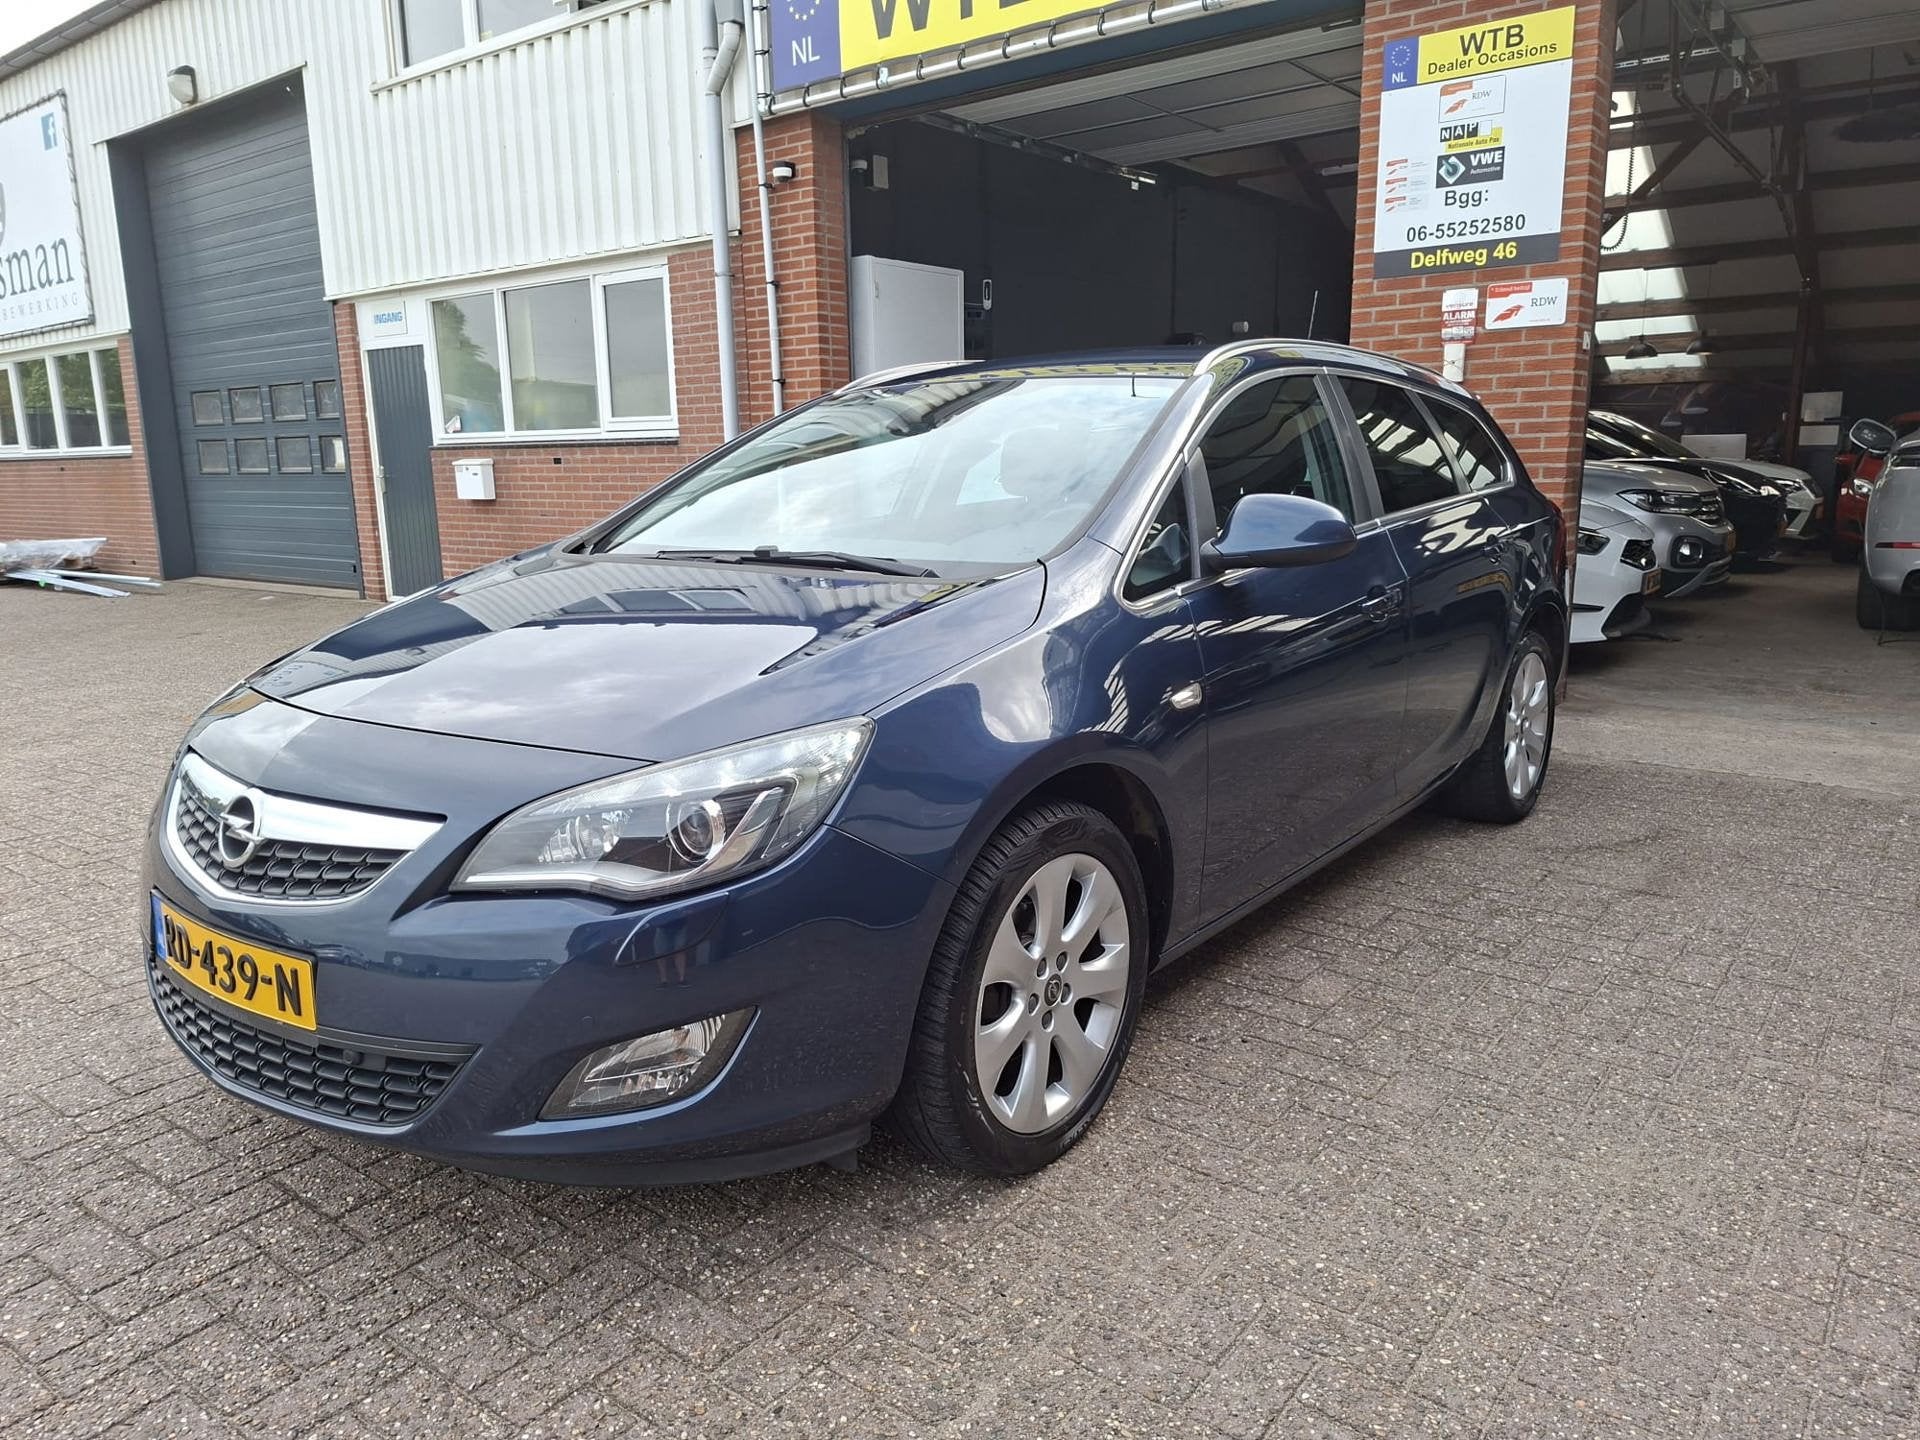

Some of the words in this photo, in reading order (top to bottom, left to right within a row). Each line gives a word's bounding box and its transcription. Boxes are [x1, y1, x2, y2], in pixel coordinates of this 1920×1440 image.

[1460, 23, 1525, 56] WTB
[792, 36, 820, 66] NL
[1428, 57, 1474, 76] Dealer
[1478, 41, 1557, 66] Occasions
[1391, 72, 1408, 84] NL
[1472, 89, 1492, 100] RDW
[1441, 121, 1477, 140] NAP
[1470, 150, 1503, 166] VWE
[1444, 188, 1489, 208] Bgg:
[1406, 213, 1526, 243] 06-55252580
[1410, 247, 1488, 269] Delfweg
[1493, 241, 1518, 260] 46
[1530, 296, 1558, 307] RDW
[1443, 310, 1476, 321] ALARM
[164, 914, 302, 1017] RD-439-N
